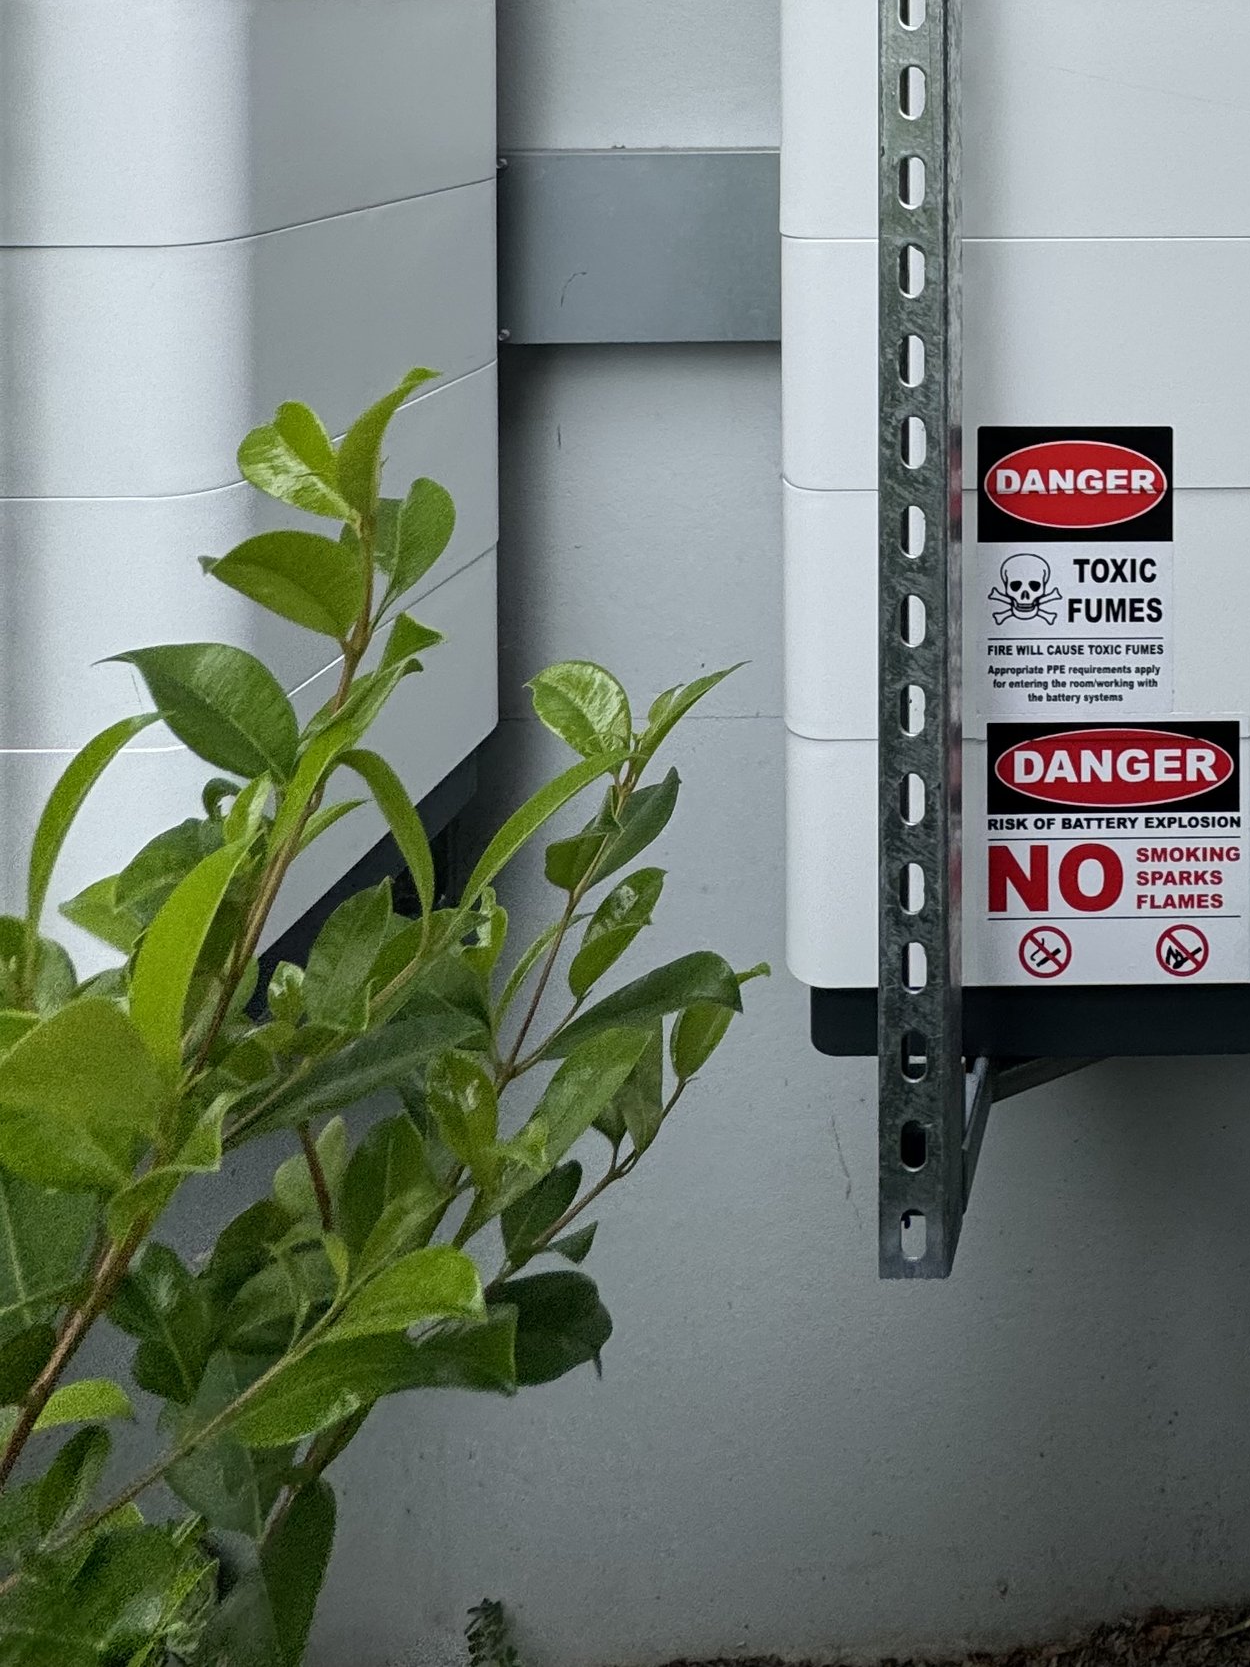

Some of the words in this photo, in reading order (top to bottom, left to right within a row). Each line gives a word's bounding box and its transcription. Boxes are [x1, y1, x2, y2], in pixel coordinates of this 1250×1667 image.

[995, 468, 1158, 495] DANGER
[1073, 557, 1158, 584] TOXIC
[1067, 597, 1163, 624] FUMES
[987, 645, 1014, 656] FIRE
[1016, 645, 1044, 656] WILL
[1047, 644, 1085, 656] CAUSE
[1088, 644, 1122, 655] TOXIC
[1125, 644, 1164, 655] FUMES
[987, 665, 1044, 676] Appropriate
[1046, 665, 1066, 674] PPE
[1068, 665, 1132, 676] requirements
[1134, 664, 1161, 676] apply
[993, 679, 1006, 688] for
[1008, 679, 1049, 690] entering
[1051, 679, 1067, 688] the
[1069, 678, 1135, 690] room/working
[1137, 678, 1159, 688] with
[1028, 693, 1043, 702] the
[1046, 693, 1081, 704] battery
[1083, 693, 1124, 704] systems
[1013, 748, 1218, 784] DANGER
[987, 818, 1028, 831] RISK
[1033, 817, 1056, 830] OF
[1061, 817, 1139, 830] BATTERY
[1144, 816, 1241, 829] EXPLOSION
[1136, 846, 1241, 863] SMOKING
[988, 843, 1124, 912] NO
[1136, 869, 1223, 886] SPARKS
[1136, 893, 1224, 910] FLAMES
